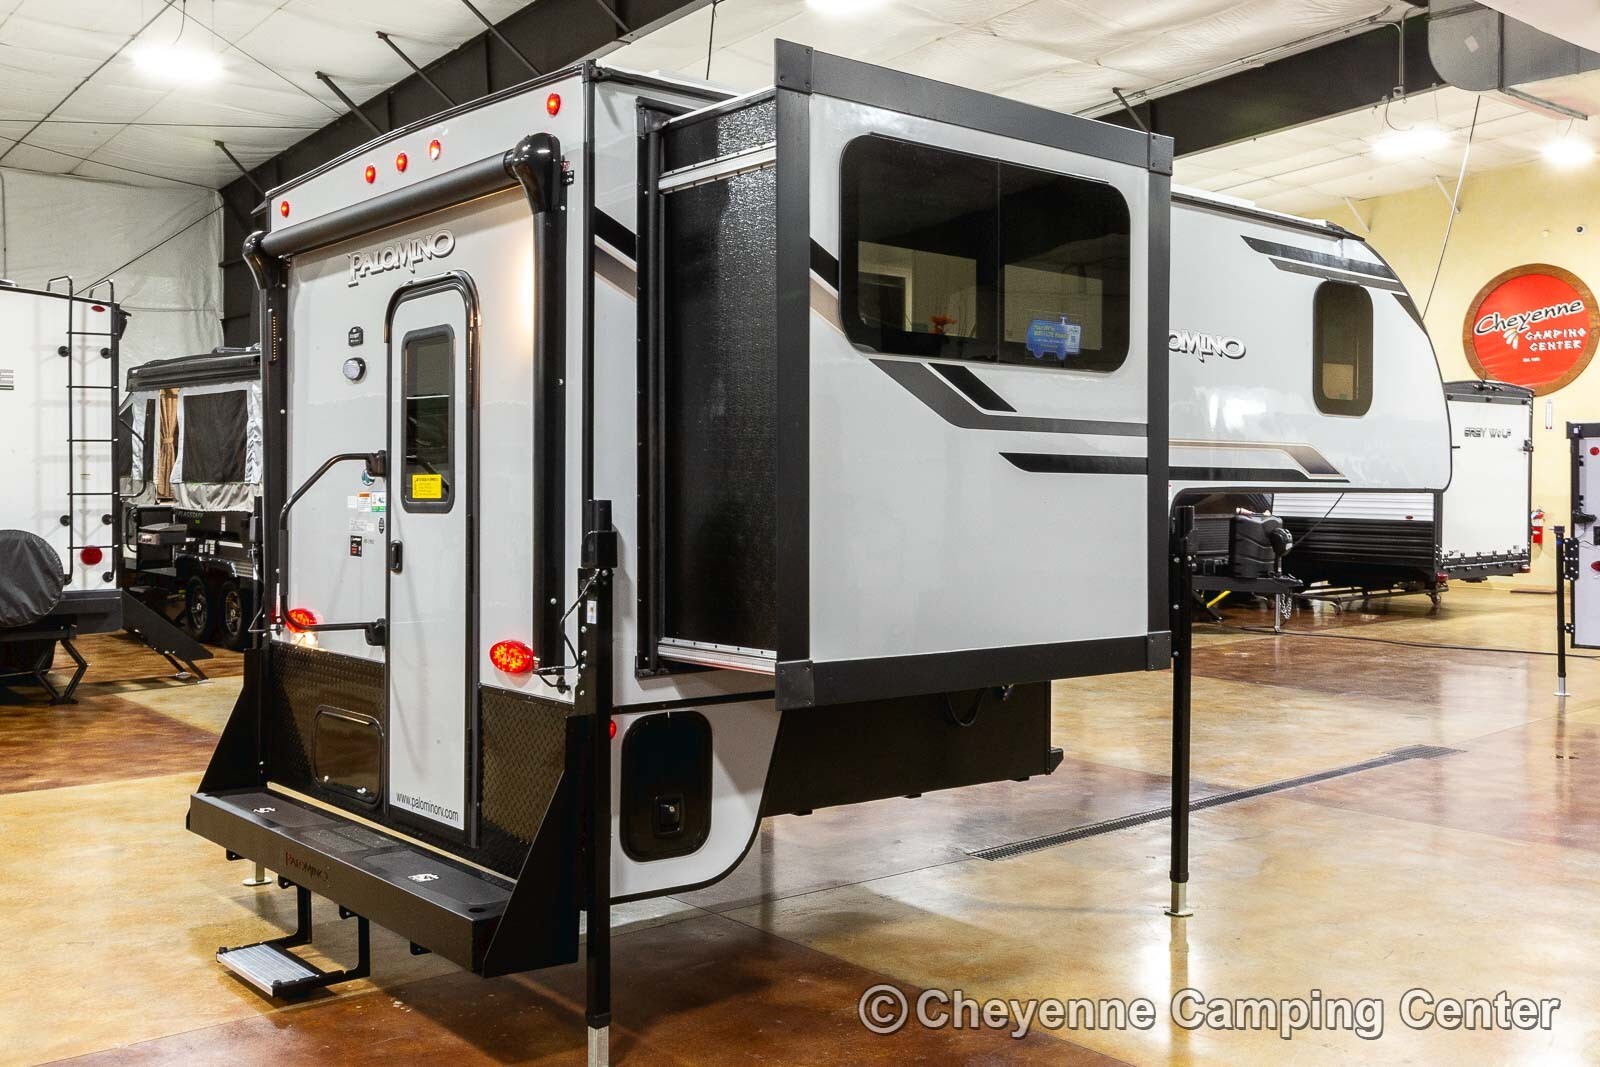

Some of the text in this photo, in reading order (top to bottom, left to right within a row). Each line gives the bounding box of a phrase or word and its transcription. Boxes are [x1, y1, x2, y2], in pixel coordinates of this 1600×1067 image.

[347, 229, 456, 288] PALOMINO
[1474, 300, 1584, 336] Cheyenne
[1524, 327, 1587, 341] CAMPING
[1529, 339, 1582, 352] CENTER
[396, 791, 459, 822] www.palominorv.com
